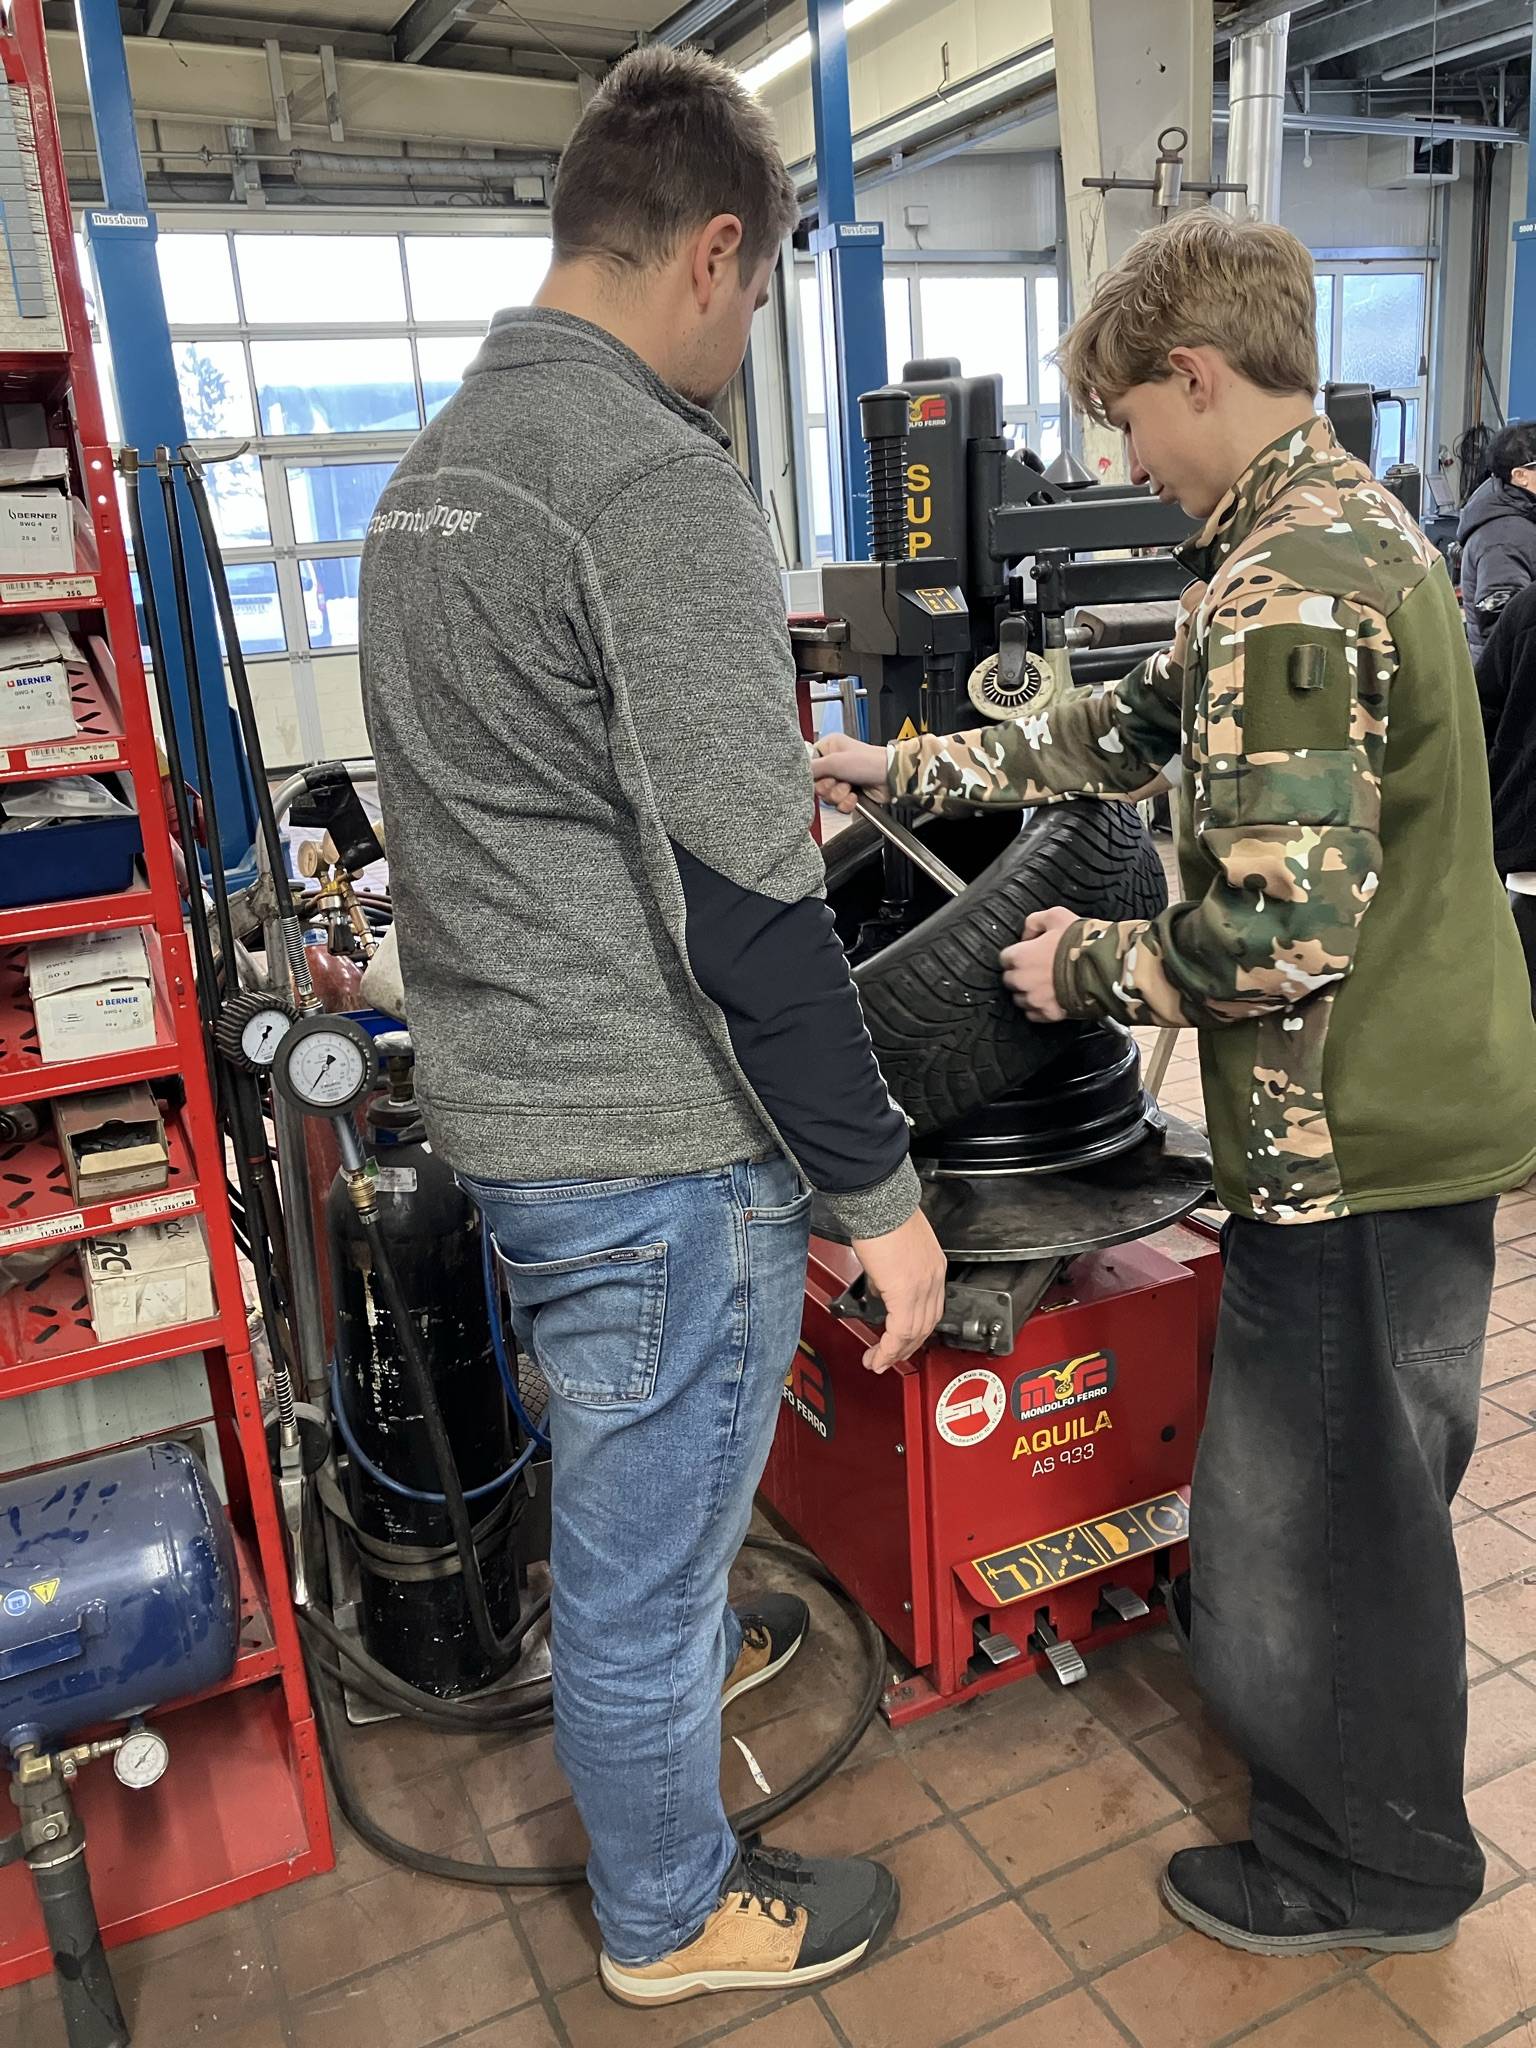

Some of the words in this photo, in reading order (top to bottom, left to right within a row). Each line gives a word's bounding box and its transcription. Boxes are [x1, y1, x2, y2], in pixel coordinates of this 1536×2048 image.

[18, 512, 58, 520] BERNER
[16, 675, 52, 687] BERNER
[105, 996, 139, 1006] BERNER
[796, 1398, 827, 1437] FERRO
[1020, 1399, 1075, 1421] MONDOLFO
[1076, 1386, 1108, 1403] FERRO
[1011, 1410, 1113, 1460] AQUILA
[1032, 1456, 1056, 1478] AS
[1059, 1442, 1094, 1465] 933
